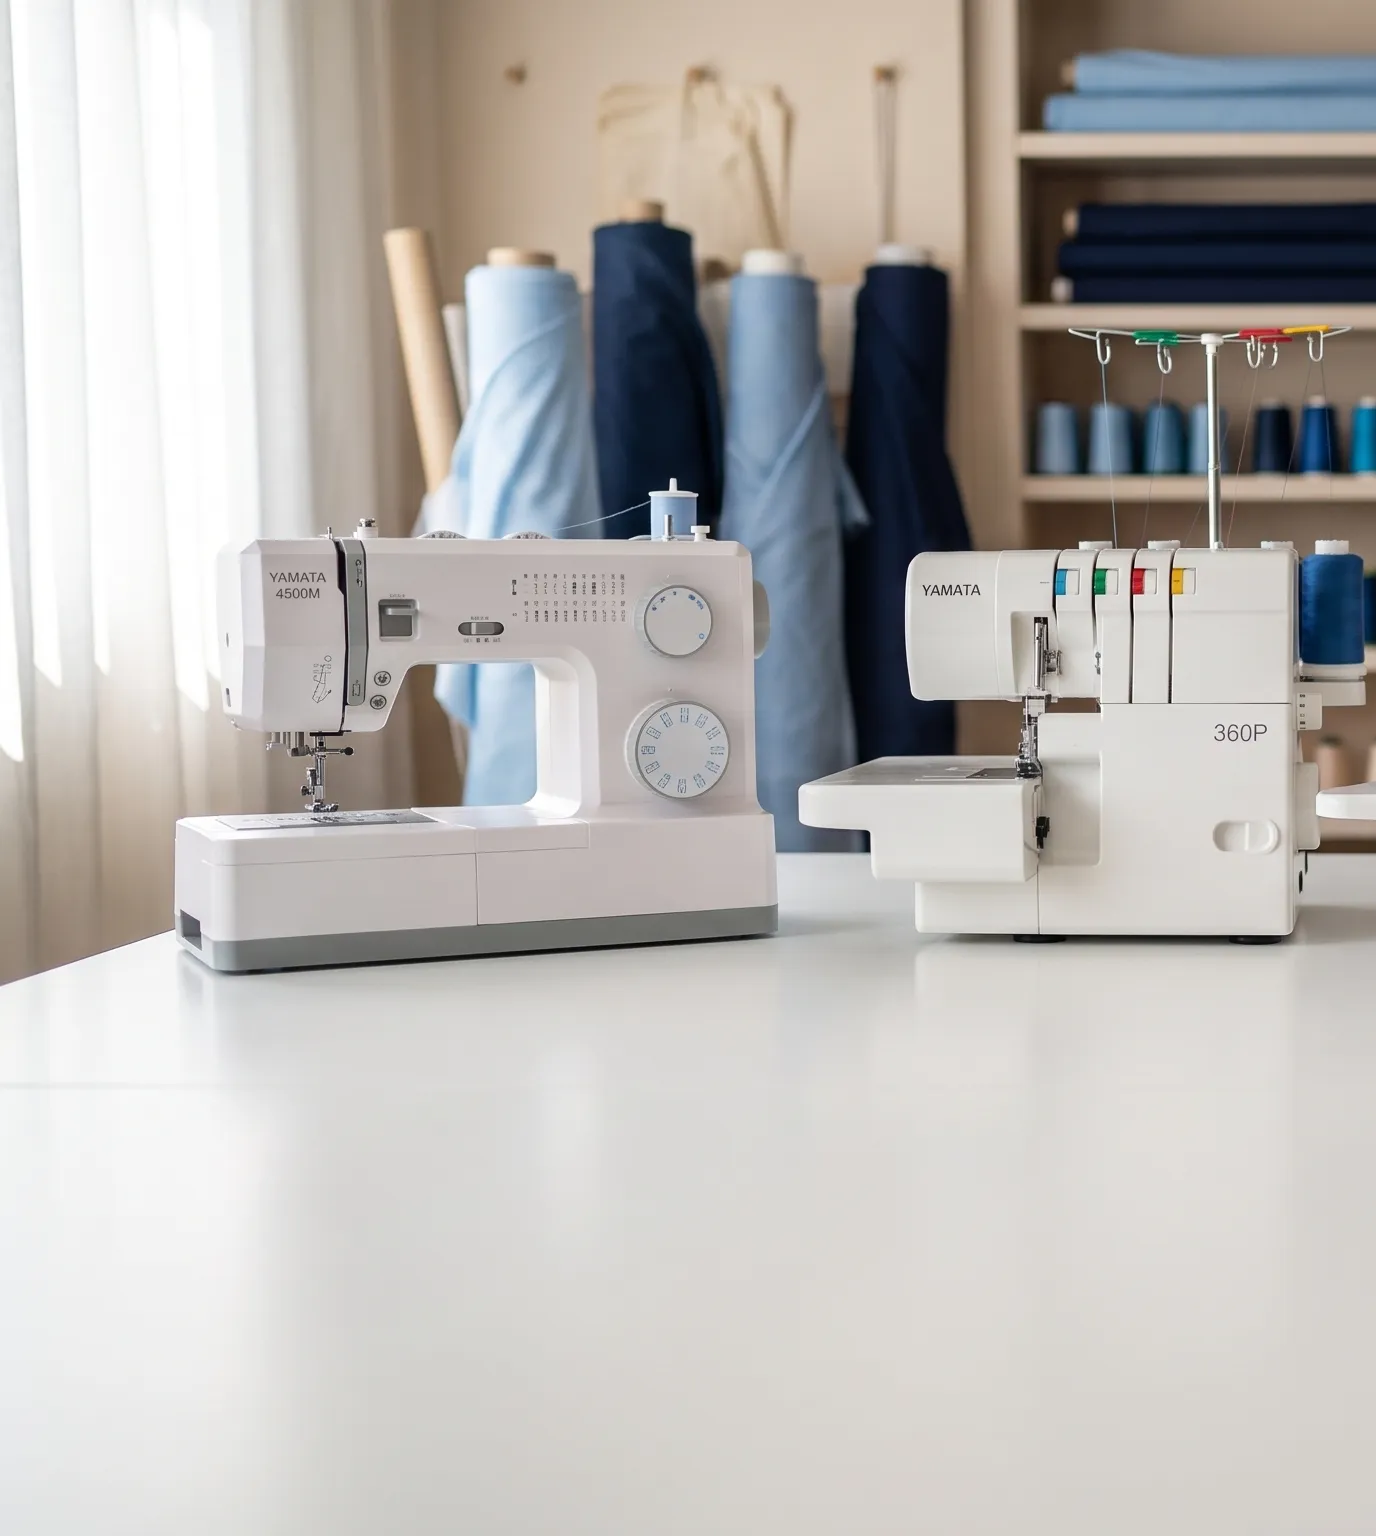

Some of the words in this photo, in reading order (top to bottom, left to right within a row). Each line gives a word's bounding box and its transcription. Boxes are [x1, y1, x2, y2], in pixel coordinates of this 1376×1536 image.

[269, 572, 327, 583] YAMATA
[275, 587, 320, 600] 4500M
[921, 583, 981, 597] YAMATA
[1213, 723, 1268, 743] 360P
